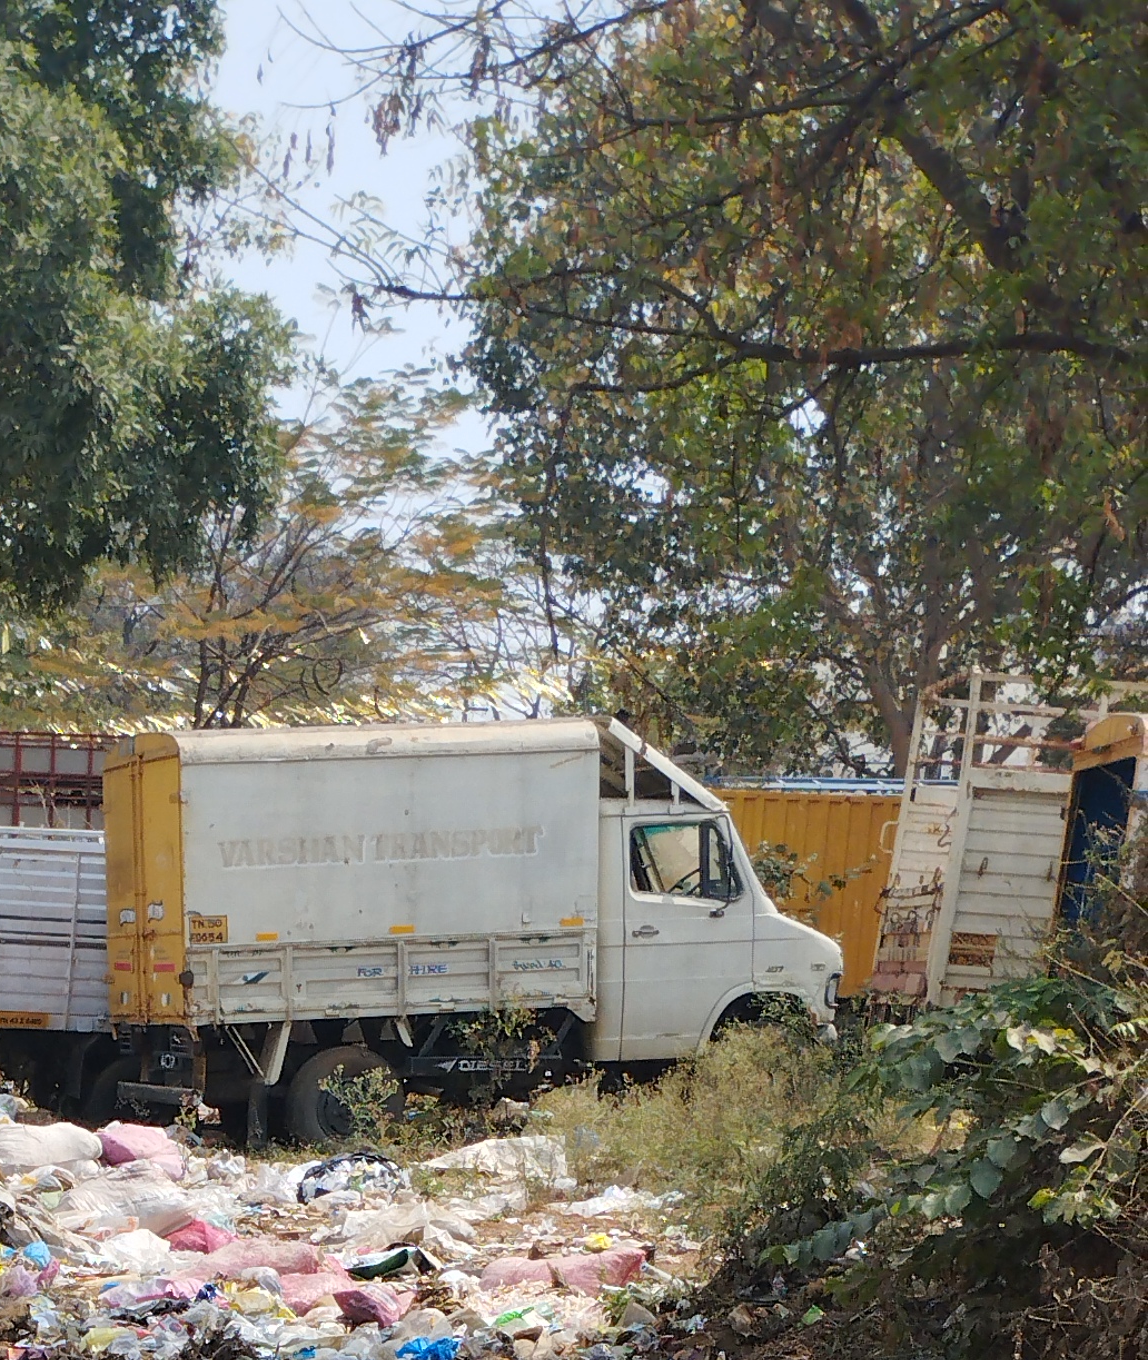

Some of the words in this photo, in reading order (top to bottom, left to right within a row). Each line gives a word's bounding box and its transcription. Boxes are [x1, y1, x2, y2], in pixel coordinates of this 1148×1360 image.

[217, 834, 365, 869] VARSHAN
[370, 825, 545, 863] TRANSPORT
[191, 919, 205, 929] TN
[357, 967, 383, 977] FOR
[408, 964, 448, 975] HIRE
